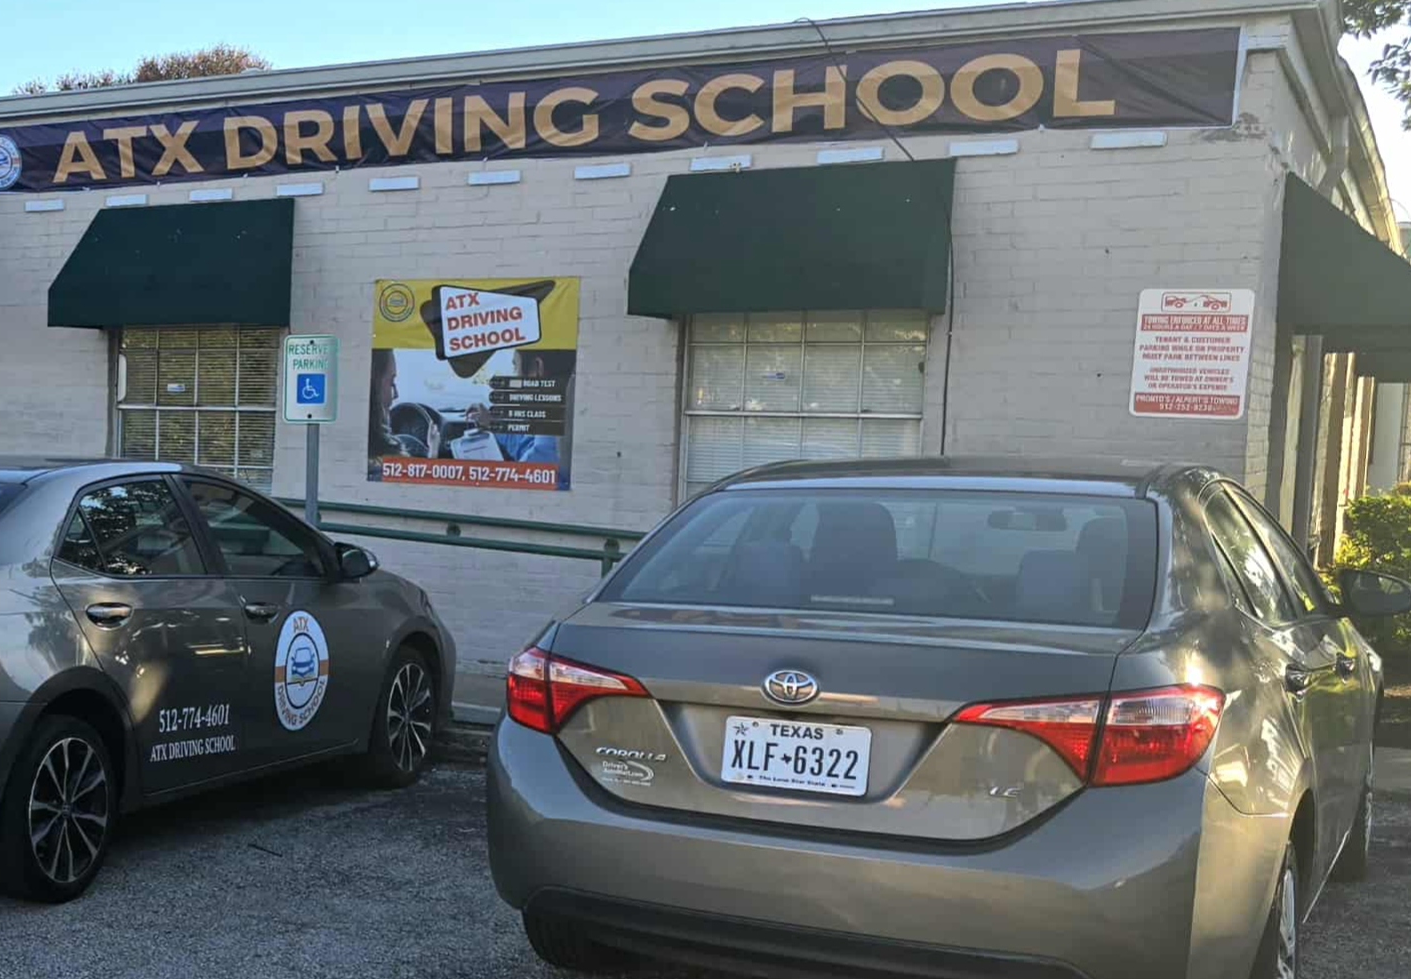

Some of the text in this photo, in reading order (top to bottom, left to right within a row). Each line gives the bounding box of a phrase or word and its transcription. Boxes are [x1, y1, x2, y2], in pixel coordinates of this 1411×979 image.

[52, 49, 1115, 184] ATX DRIVING SCHOOL
[446, 292, 480, 310] ATX
[447, 306, 522, 330] DRIVING
[288, 344, 330, 355] RESERVE
[449, 328, 526, 351] SCHOOL
[382, 462, 556, 484] 512-817-0007, 512-774-4601
[293, 616, 309, 633] ATX
[299, 677, 326, 724] SCHOOL
[159, 704, 230, 733] 512-774-4601
[770, 723, 824, 740] TEXAS
[150, 735, 236, 762] ATX DRIVING SCHOOL
